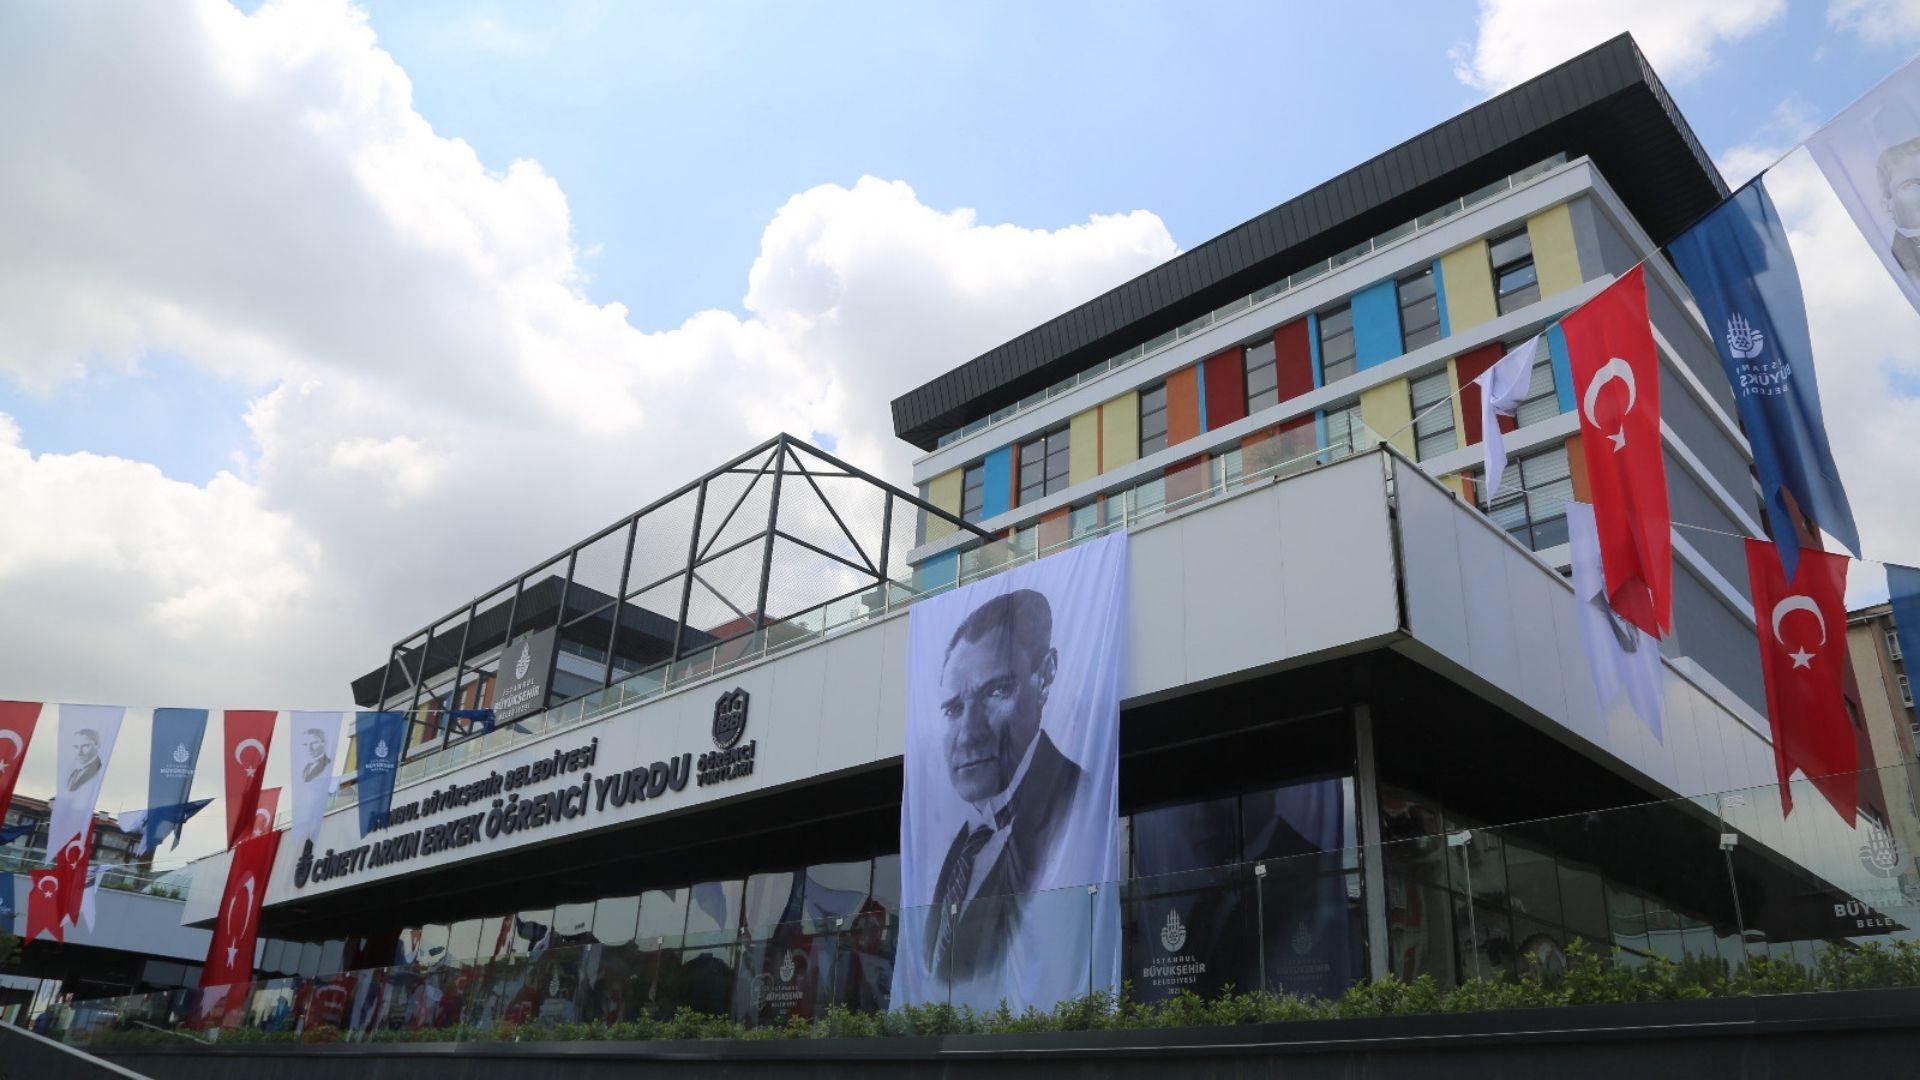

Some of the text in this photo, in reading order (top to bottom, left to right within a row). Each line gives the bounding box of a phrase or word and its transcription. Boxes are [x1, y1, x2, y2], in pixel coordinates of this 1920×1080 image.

[312, 753, 691, 883] CÜNEYT ARKIN ERKEK ÖĞRENCİ YURDU
[421, 770, 504, 818] BÜYÜKŞEHİR
[504, 736, 598, 791] BELEDİYESİ
[1143, 962, 1206, 978] BÜYÜKŞEHİR
